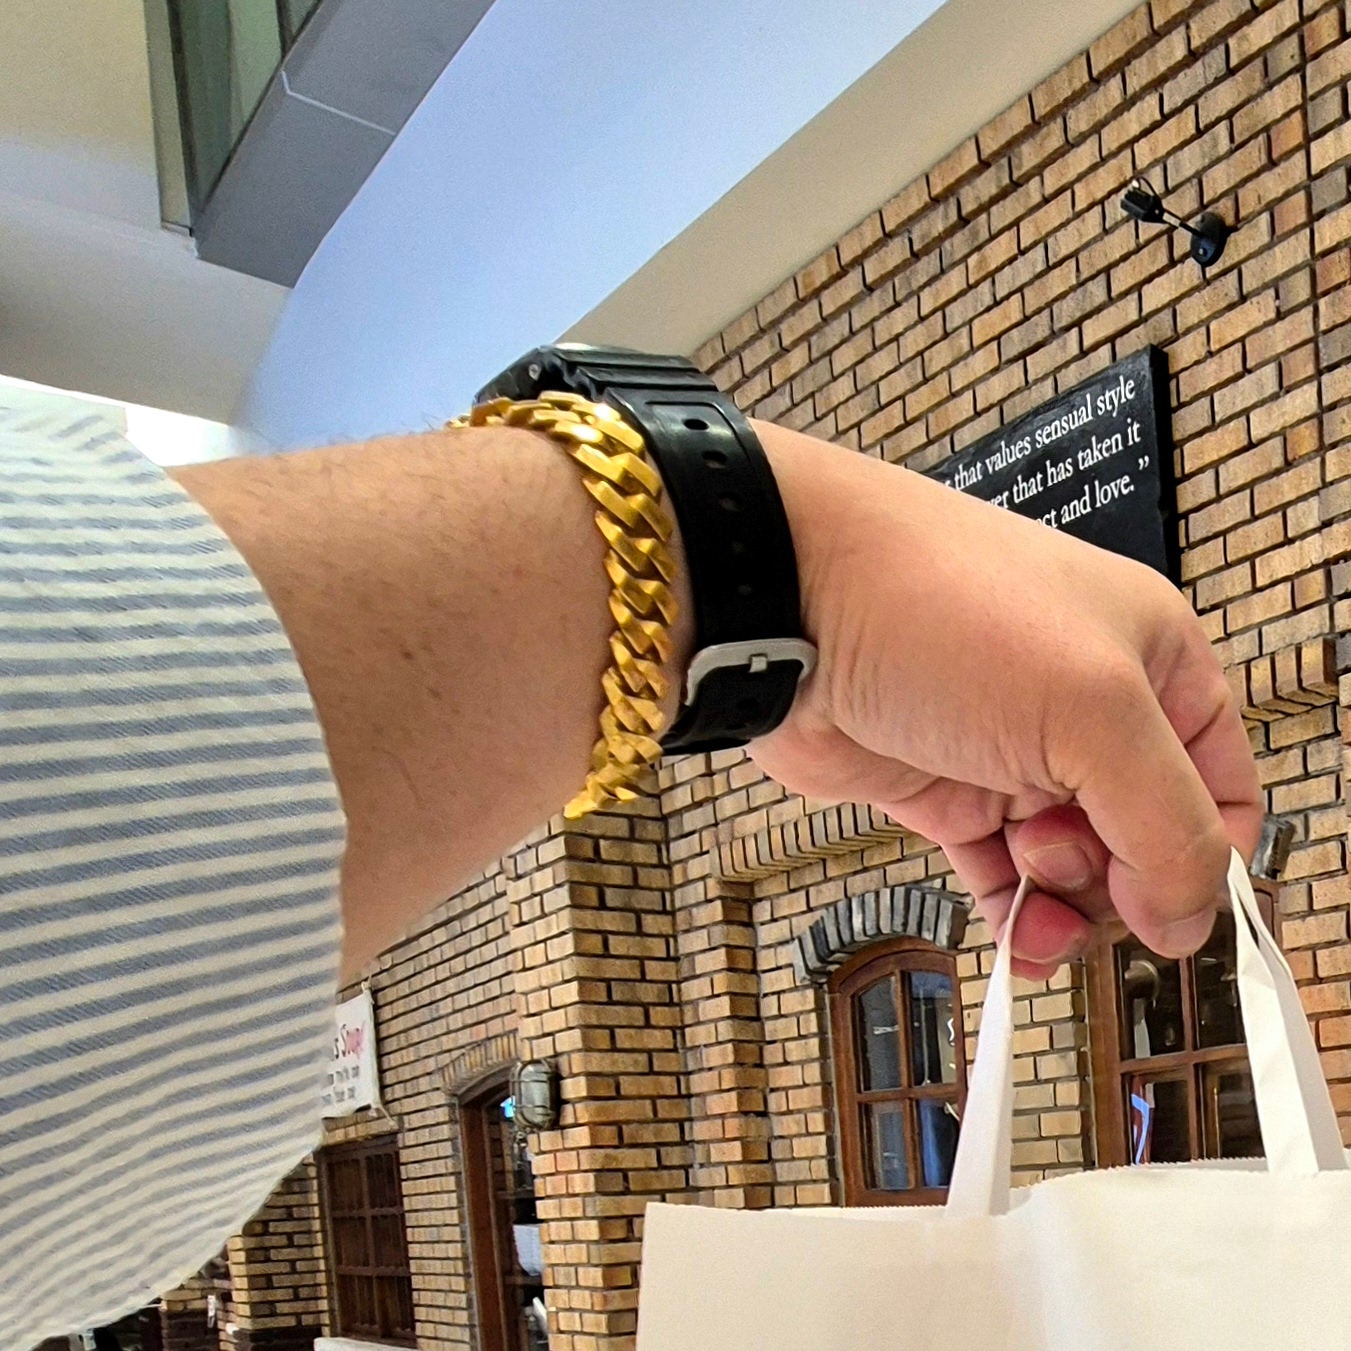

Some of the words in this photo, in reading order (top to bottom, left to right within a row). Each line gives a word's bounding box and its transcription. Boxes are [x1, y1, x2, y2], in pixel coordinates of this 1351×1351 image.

[954, 463, 983, 491] that
[985, 434, 1031, 476] values
[1035, 393, 1093, 449] sensual
[1097, 375, 1135, 417] style
[1013, 472, 1043, 504] that
[1046, 460, 1073, 487] has
[1077, 434, 1123, 470] taken
[1126, 417, 1141, 449] it
[1061, 484, 1091, 523] and
